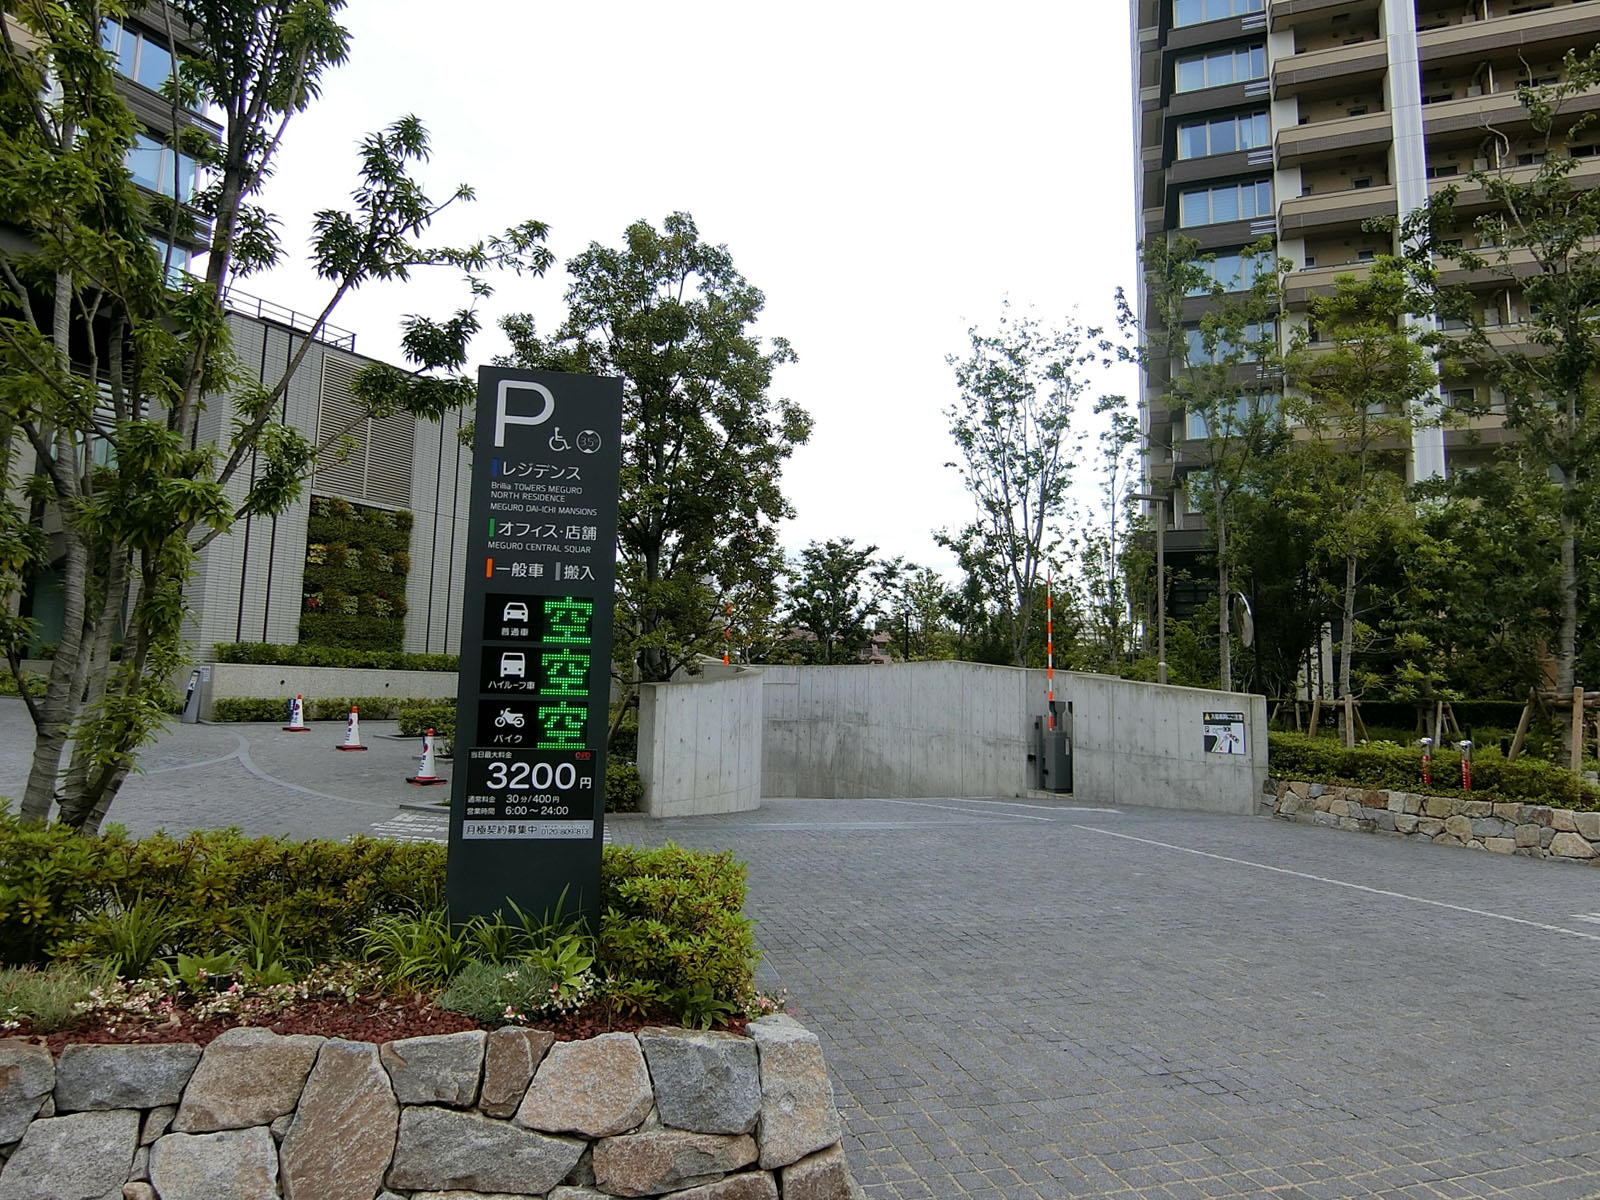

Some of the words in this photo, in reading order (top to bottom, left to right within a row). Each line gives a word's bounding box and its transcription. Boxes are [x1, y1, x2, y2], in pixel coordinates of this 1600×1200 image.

[494, 379, 555, 447] P
[502, 461, 582, 481] レジデンス
[490, 481, 512, 490] Brillia
[514, 483, 546, 492] TOWERS
[548, 485, 583, 495] MEGURO
[490, 491, 520, 500] NORTH
[522, 492, 566, 503] RESIDENCE
[490, 502, 524, 512] MEGURO
[526, 504, 557, 514] DAI-ICHI
[558, 507, 598, 517] MANSIONS
[498, 521, 597, 541] オフィス・店舗
[487, 541, 523, 550] MEGURO
[525, 542, 562, 552] CENTRAL
[564, 544, 592, 554] SQUAR
[495, 562, 545, 578] 一般車
[563, 564, 596, 581] 搬入
[542, 596, 593, 643] 空
[540, 648, 591, 695] 空
[487, 681, 536, 690] ハイルーフ車
[537, 701, 588, 749] 空
[493, 734, 523, 744] バイク
[470, 751, 513, 759] 当日最大料金
[466, 807, 496, 815] 営業時間
[465, 824, 538, 835] 月極契約募集中
